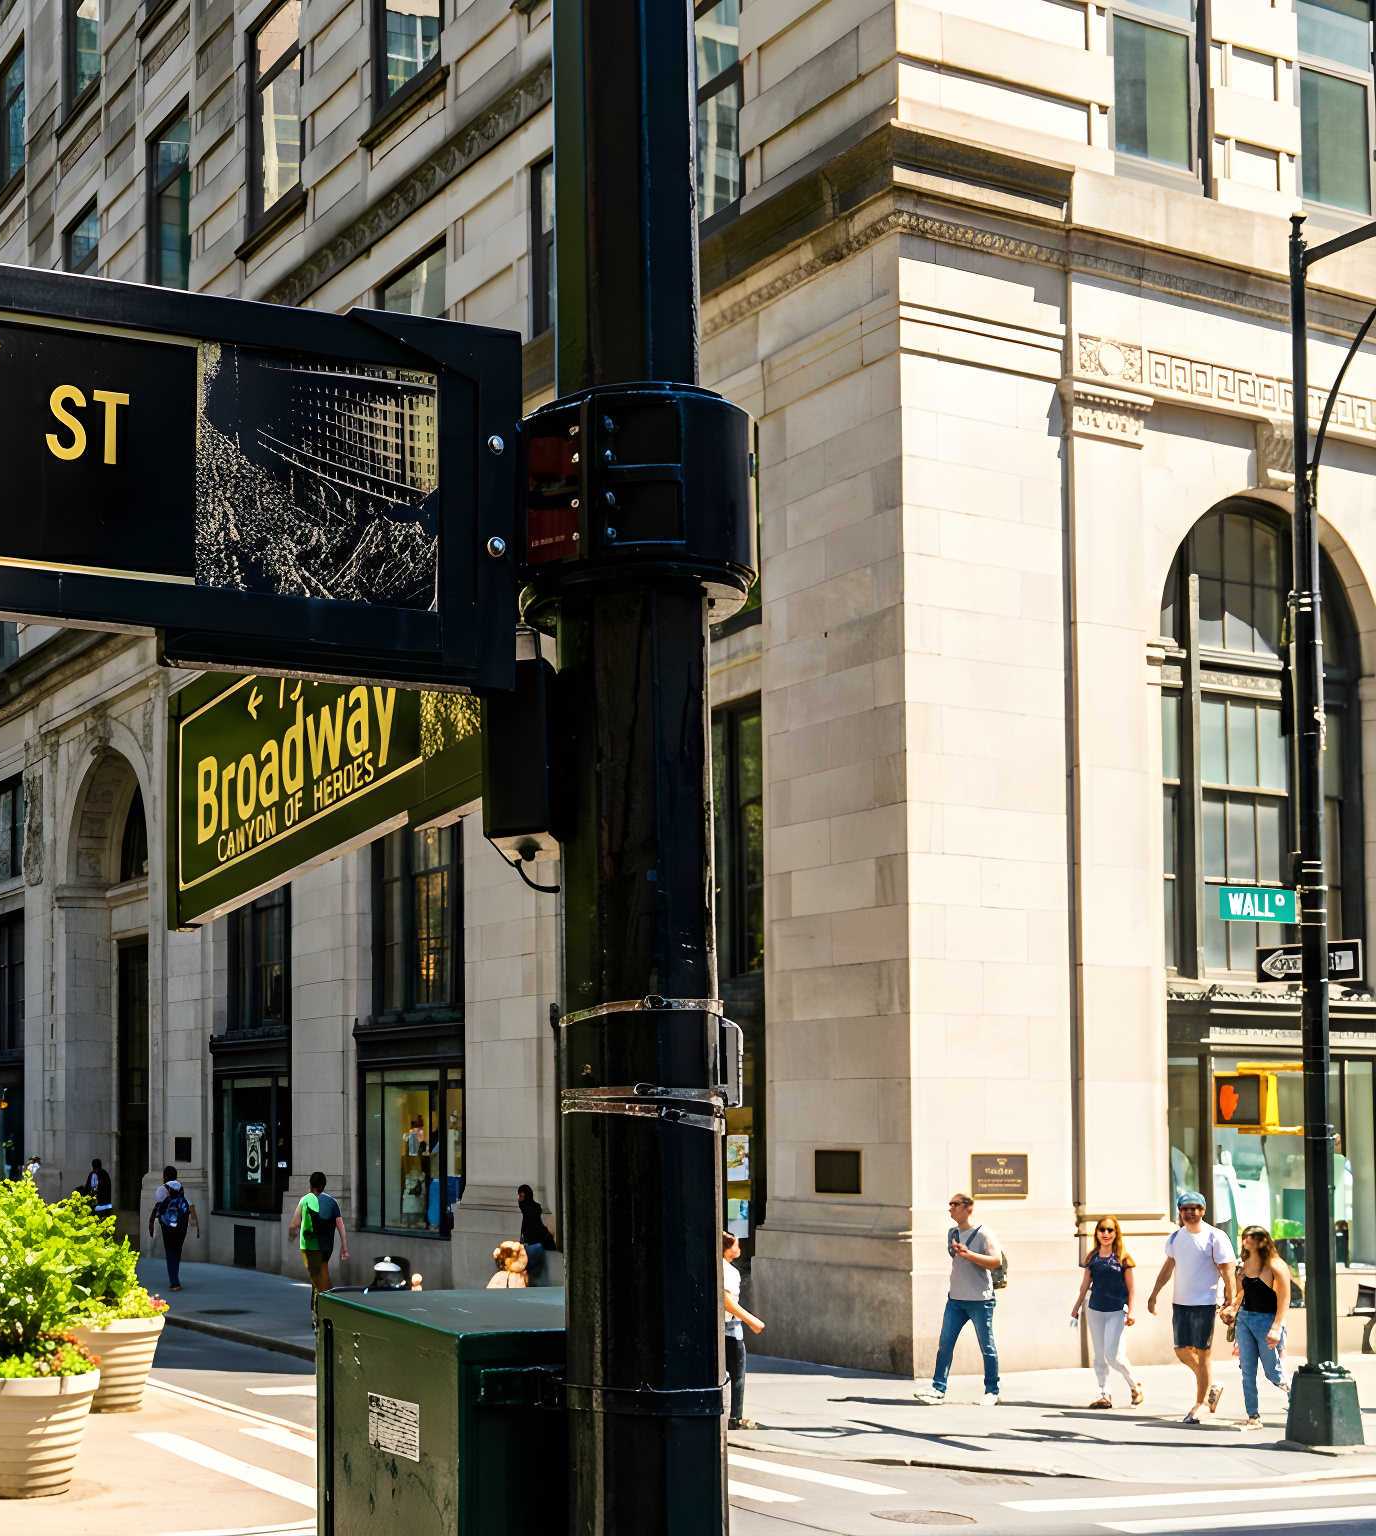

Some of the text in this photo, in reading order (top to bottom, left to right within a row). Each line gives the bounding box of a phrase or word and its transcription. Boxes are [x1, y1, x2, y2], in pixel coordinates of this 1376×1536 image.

[45, 384, 130, 465] ST
[197, 685, 397, 845] Broadway
[217, 751, 375, 863] CANYON OF HEROES
[1228, 892, 1276, 918] WALL
